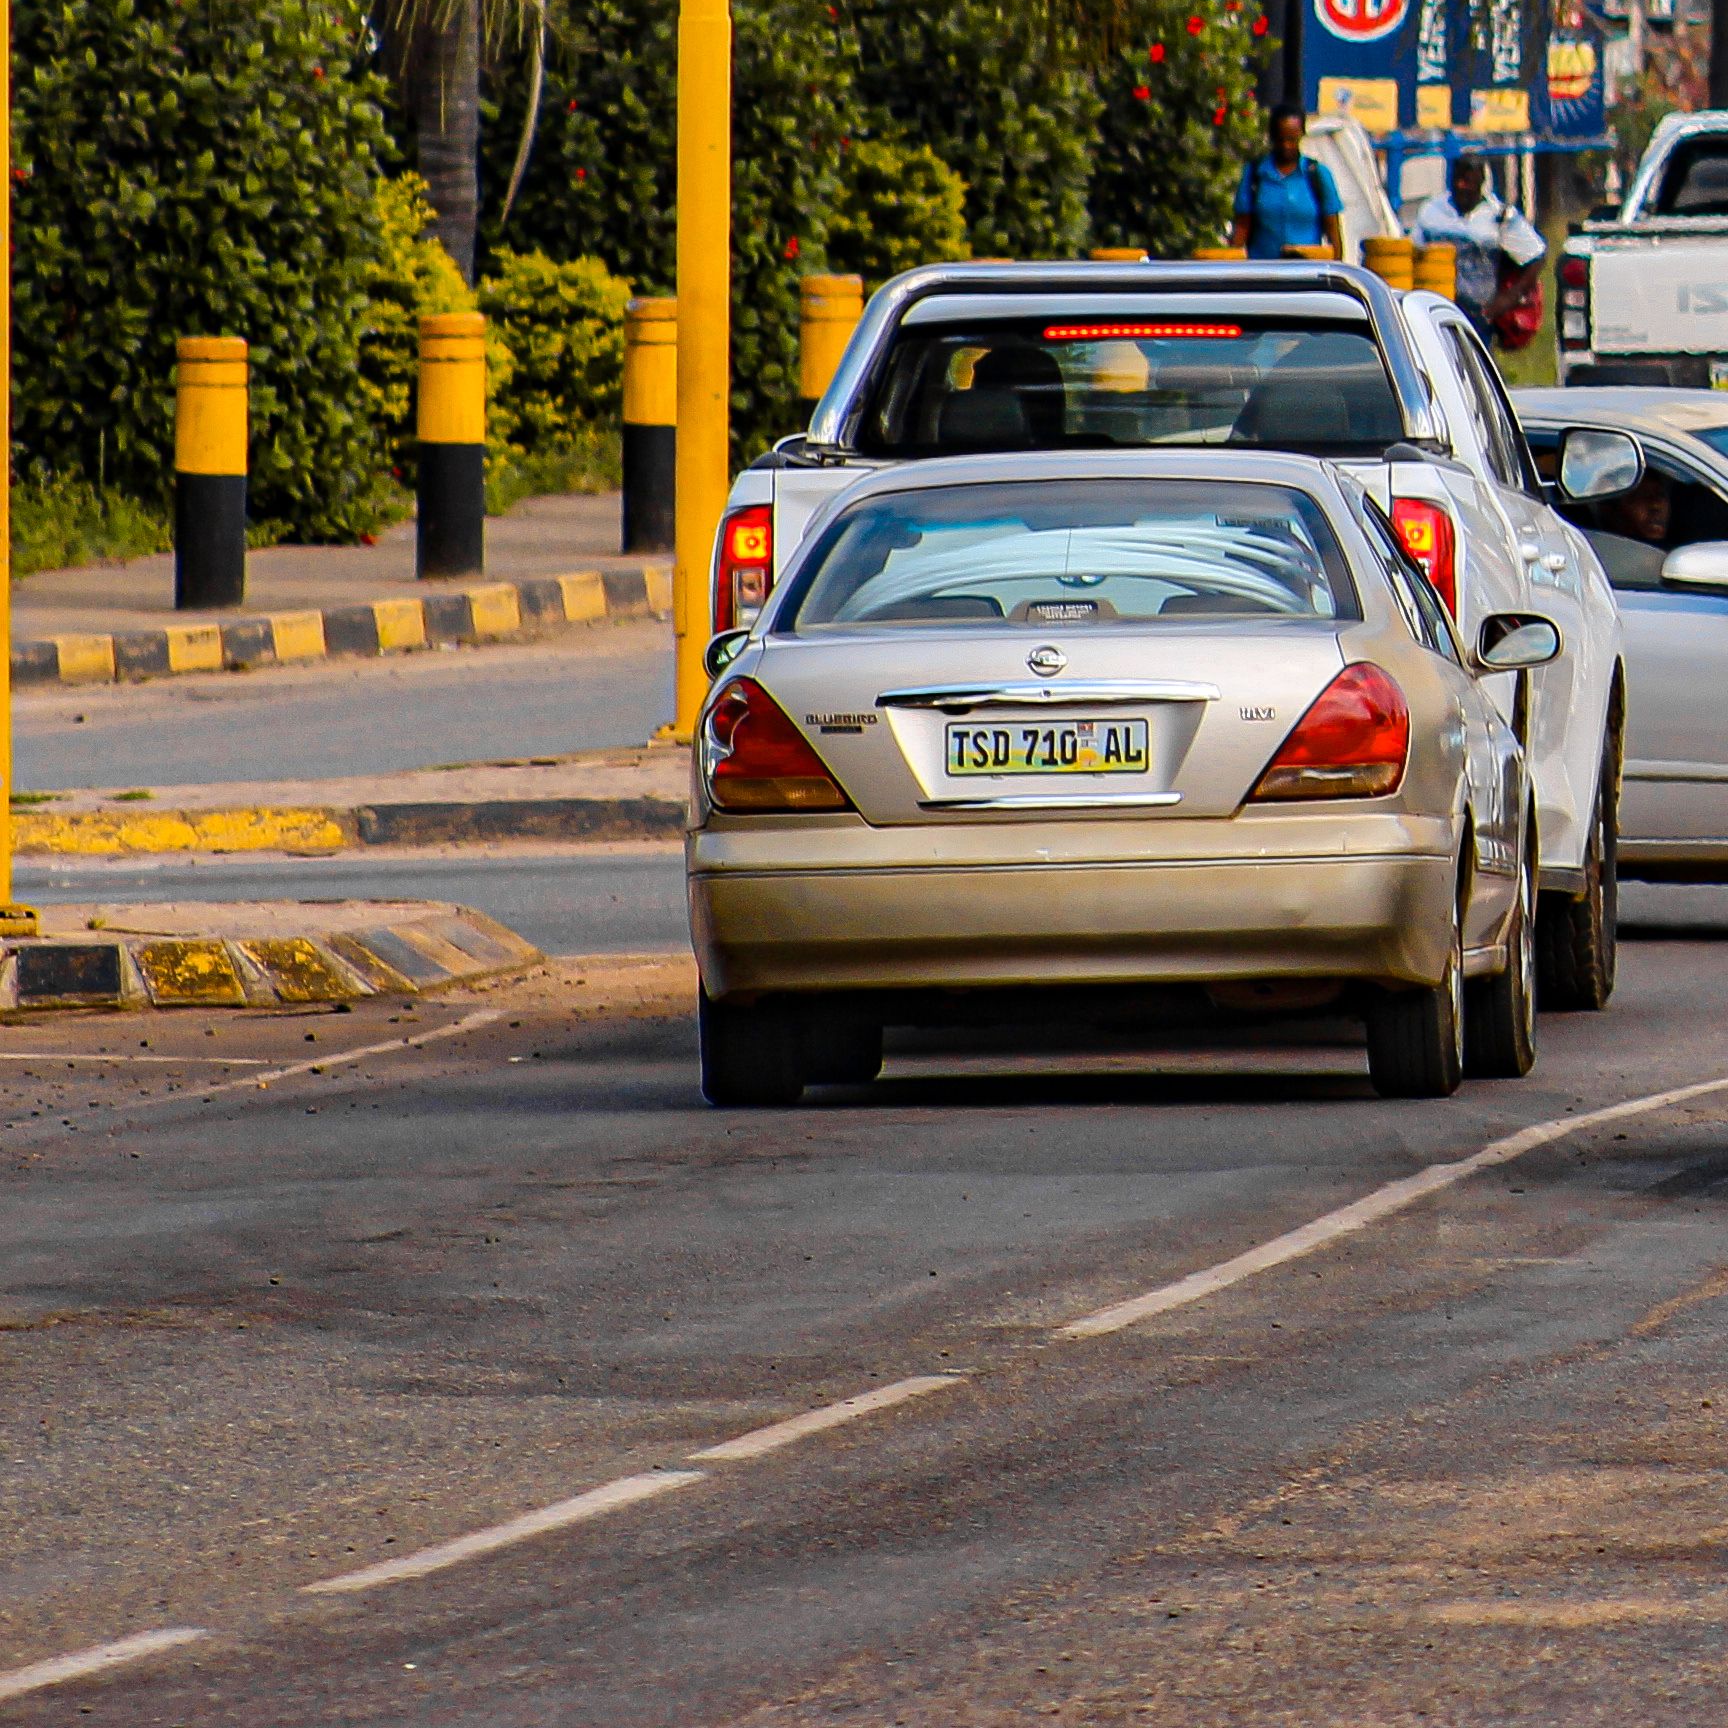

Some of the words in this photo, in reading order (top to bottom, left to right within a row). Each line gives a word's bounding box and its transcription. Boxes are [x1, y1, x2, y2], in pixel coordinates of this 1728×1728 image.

[953, 730, 1010, 768] TSD
[1022, 729, 1078, 766] 710
[1104, 726, 1143, 763] AL
